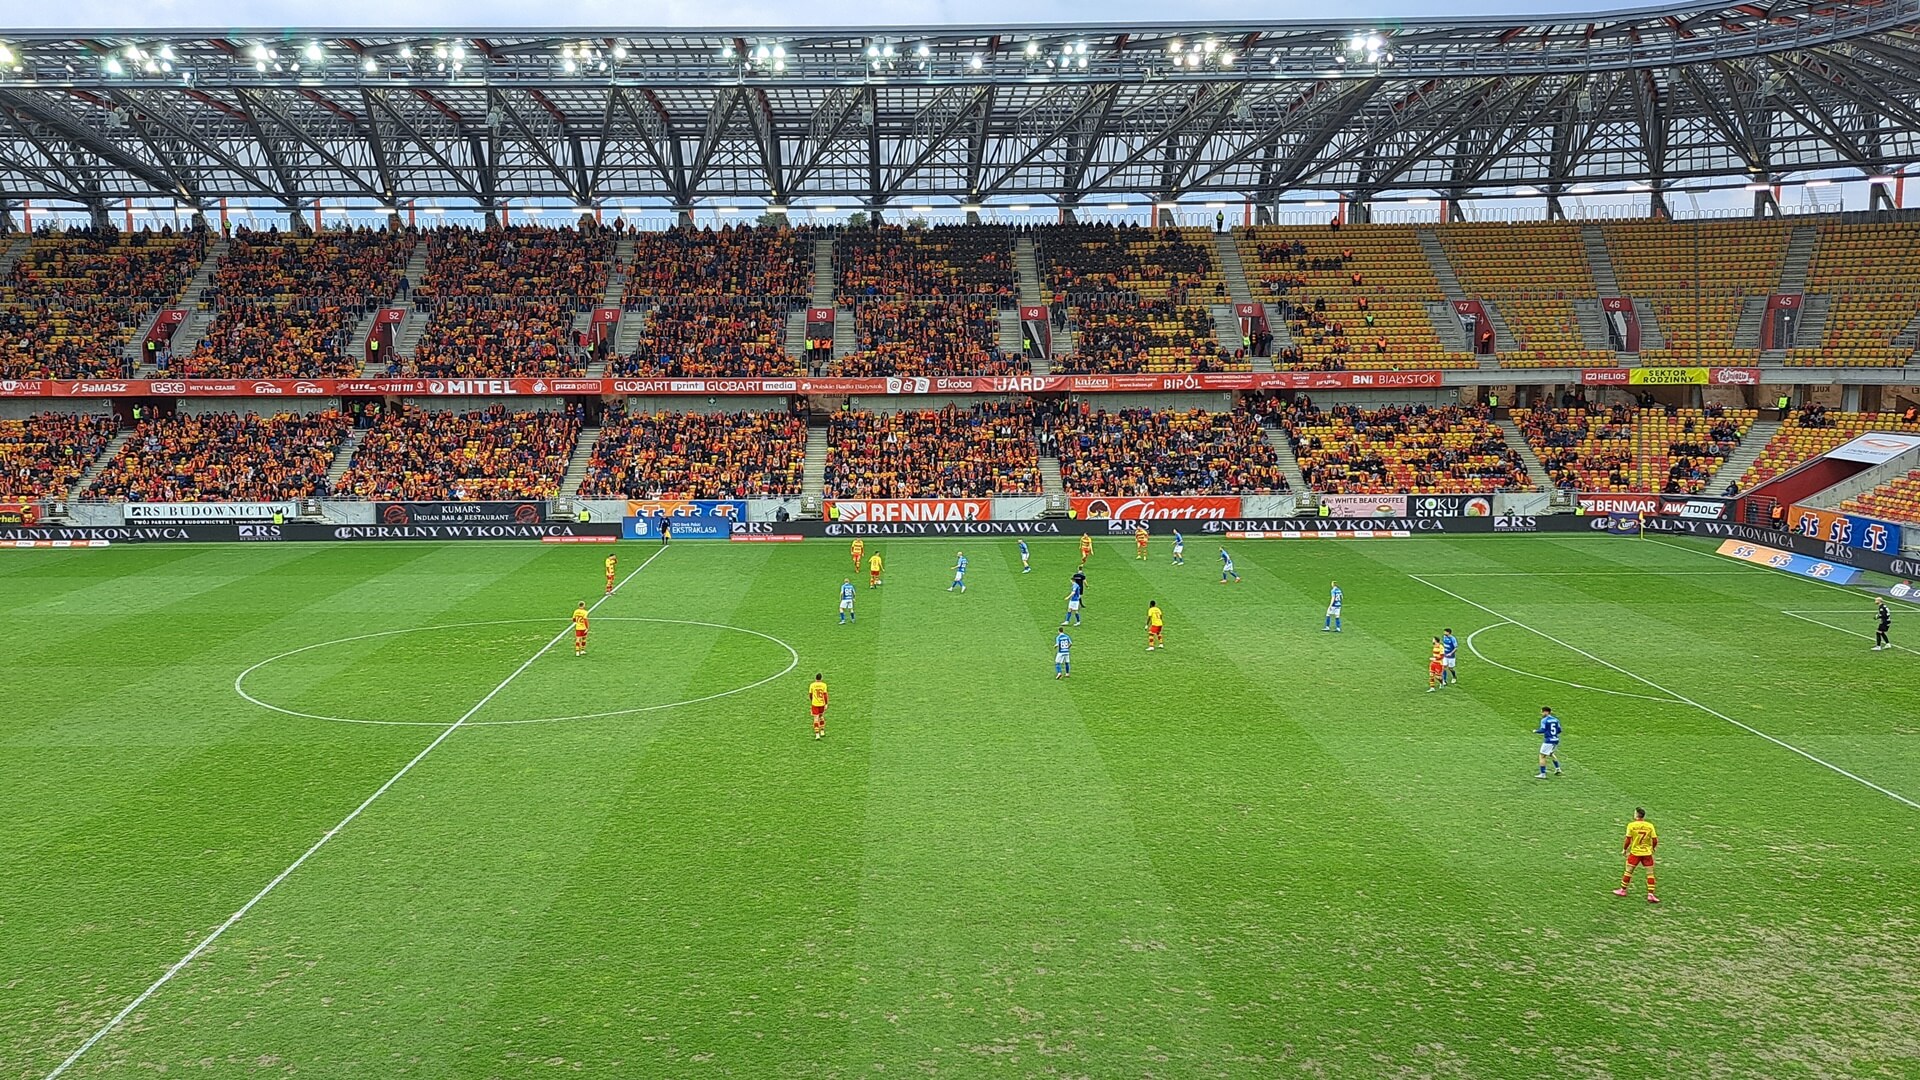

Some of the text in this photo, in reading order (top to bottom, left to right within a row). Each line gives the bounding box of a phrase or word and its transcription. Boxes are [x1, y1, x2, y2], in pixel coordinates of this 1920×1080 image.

[1780, 297, 1792, 305] 45
[1458, 303, 1469, 311] 47
[389, 312, 399, 320] 52
[1028, 309, 1038, 317] 49
[948, 379, 972, 388] koba
[998, 377, 1045, 391] JARD
[1075, 377, 1108, 386] kaizen
[1352, 376, 1373, 384] BNI
[1377, 374, 1435, 384] BIAŁYSTOK
[81, 383, 128, 392] SaMASZ
[447, 381, 516, 394] MITEL
[614, 381, 669, 391] GLOBART
[677, 382, 699, 391] print
[707, 381, 761, 391] GLOBART
[1449, 389, 1457, 397] 15
[556, 397, 564, 405] 19
[629, 397, 637, 405] 19
[1415, 498, 1458, 509] KOKU
[1597, 501, 1655, 512] BENMAR
[1663, 503, 1719, 514] AW TOOLS
[144, 506, 289, 516] RS BUDOWNICTWO
[871, 503, 979, 520] BENMAR
[1115, 500, 1225, 519] Chorten
[933, 521, 1059, 533] WYKONAWCA
[1125, 520, 1149, 530] RS
[1313, 519, 1443, 531] WYKONAWCA
[1511, 517, 1536, 526] RS
[1799, 511, 1819, 538] STS
[256, 526, 281, 535] RS
[445, 526, 574, 537] WYKONAWCA
[749, 523, 773, 532] RS
[1829, 517, 1852, 544] STS
[58, 528, 189, 539] WYKONAWCA
[1703, 522, 1794, 548] WYKONAWCA
[1862, 524, 1887, 551] STS
[1733, 544, 1756, 558] STS
[1835, 544, 1853, 559] RS
[1768, 553, 1793, 567] STS
[1806, 562, 1833, 578] STS
[1550, 723, 1556, 735] 5
[1638, 831, 1647, 844] 7
